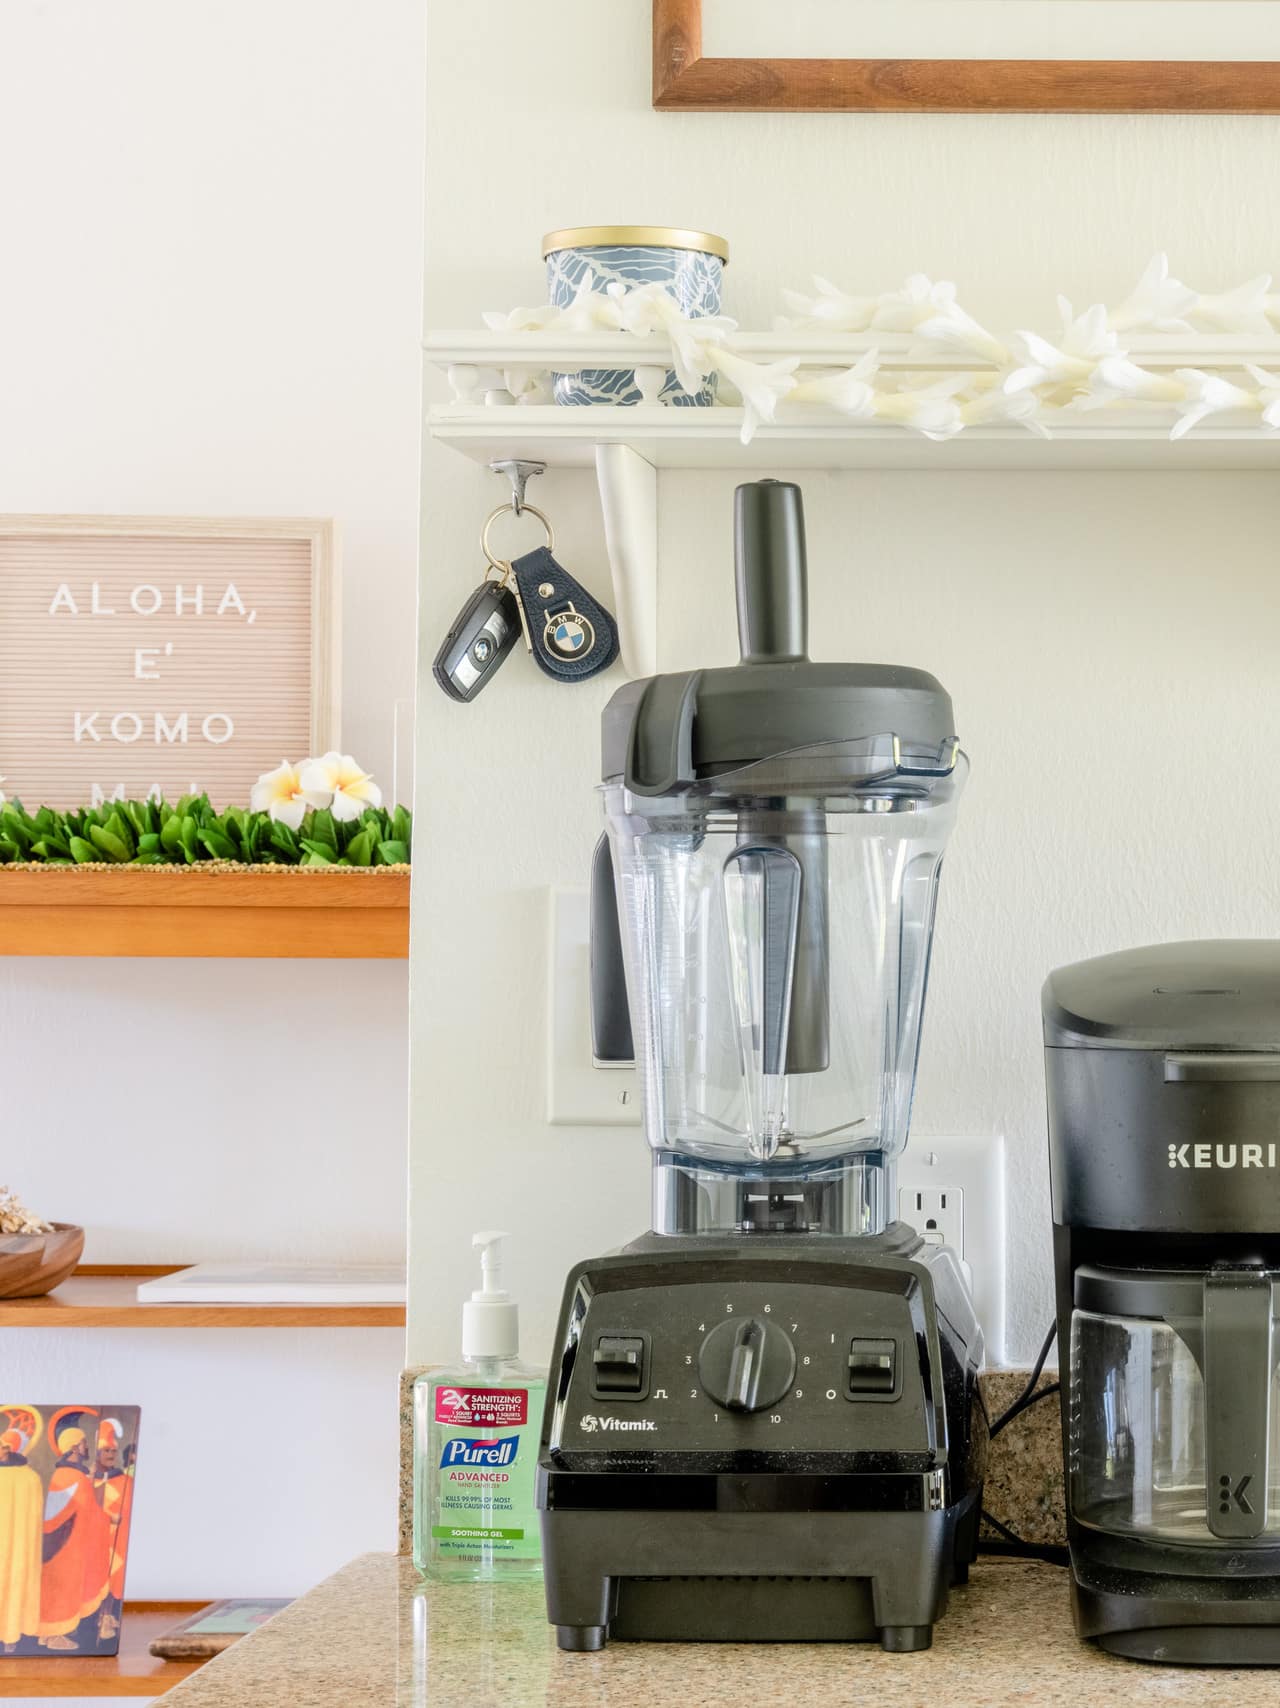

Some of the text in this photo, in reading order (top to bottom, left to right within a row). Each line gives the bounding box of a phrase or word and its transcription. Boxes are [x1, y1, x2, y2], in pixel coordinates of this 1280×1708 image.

[48, 582, 257, 625] ALOHA,
[547, 615, 586, 634] BMW
[73, 711, 235, 744] KOMO
[726, 1304, 733, 1313] 5
[764, 1304, 771, 1313] 6
[698, 1323, 705, 1332] 4
[791, 1324, 798, 1333] 7
[685, 1356, 692, 1365] 3
[803, 1356, 810, 1365] 8
[690, 1389, 697, 1398] 2
[796, 1389, 803, 1399] 9
[441, 1389, 471, 1410] 2X
[471, 1395, 522, 1404] SANITIZING
[714, 1414, 719, 1423] 1
[770, 1415, 781, 1424] 10
[449, 1440, 513, 1464] Purell
[449, 1472, 510, 1482] ADVANCED
[451, 1529, 489, 1537] SOOTHING
